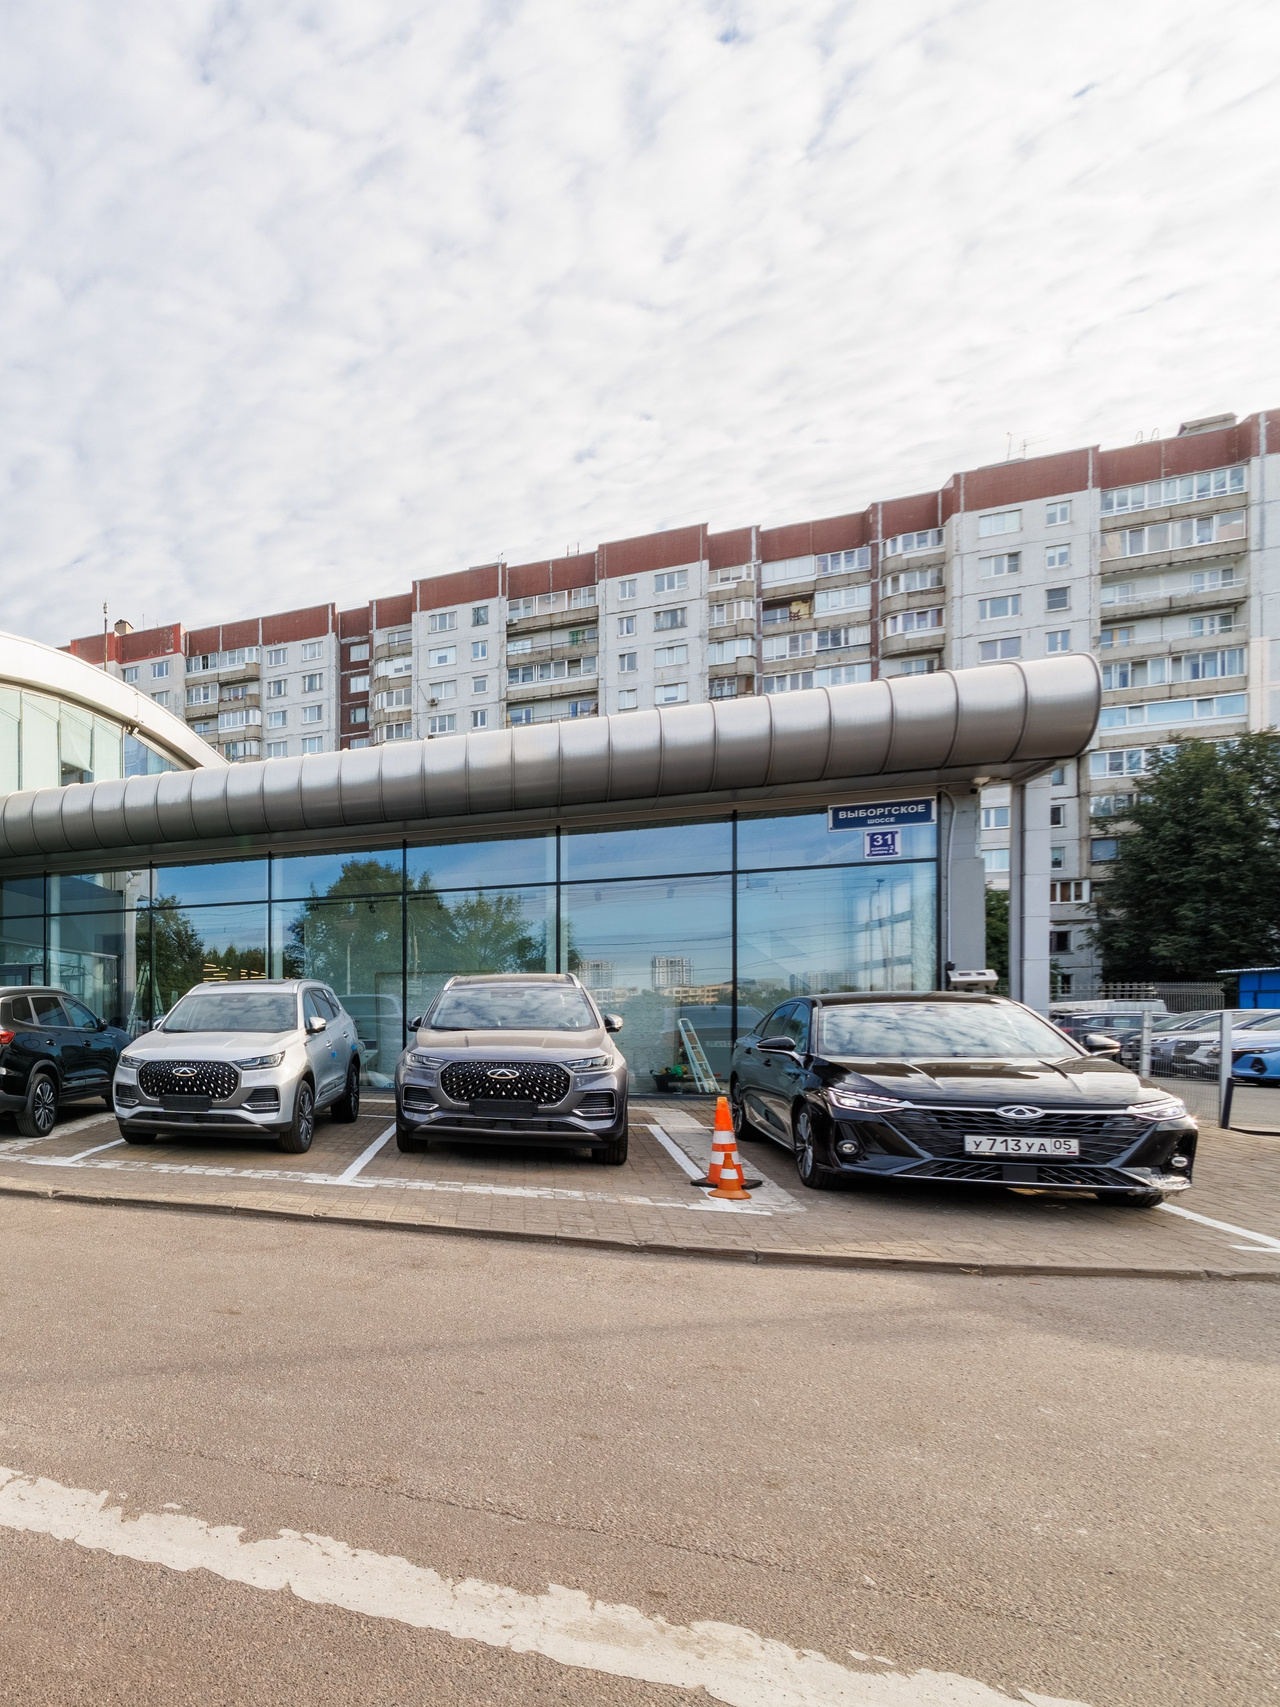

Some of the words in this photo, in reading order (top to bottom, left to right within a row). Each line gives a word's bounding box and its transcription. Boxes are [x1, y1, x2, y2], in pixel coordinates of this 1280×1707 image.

[838, 804, 926, 819] ВЫБОРГСКОЕ
[867, 816, 896, 824] ШОССЕ
[873, 833, 893, 846] 31
[1053, 1139, 1072, 1150] 05
